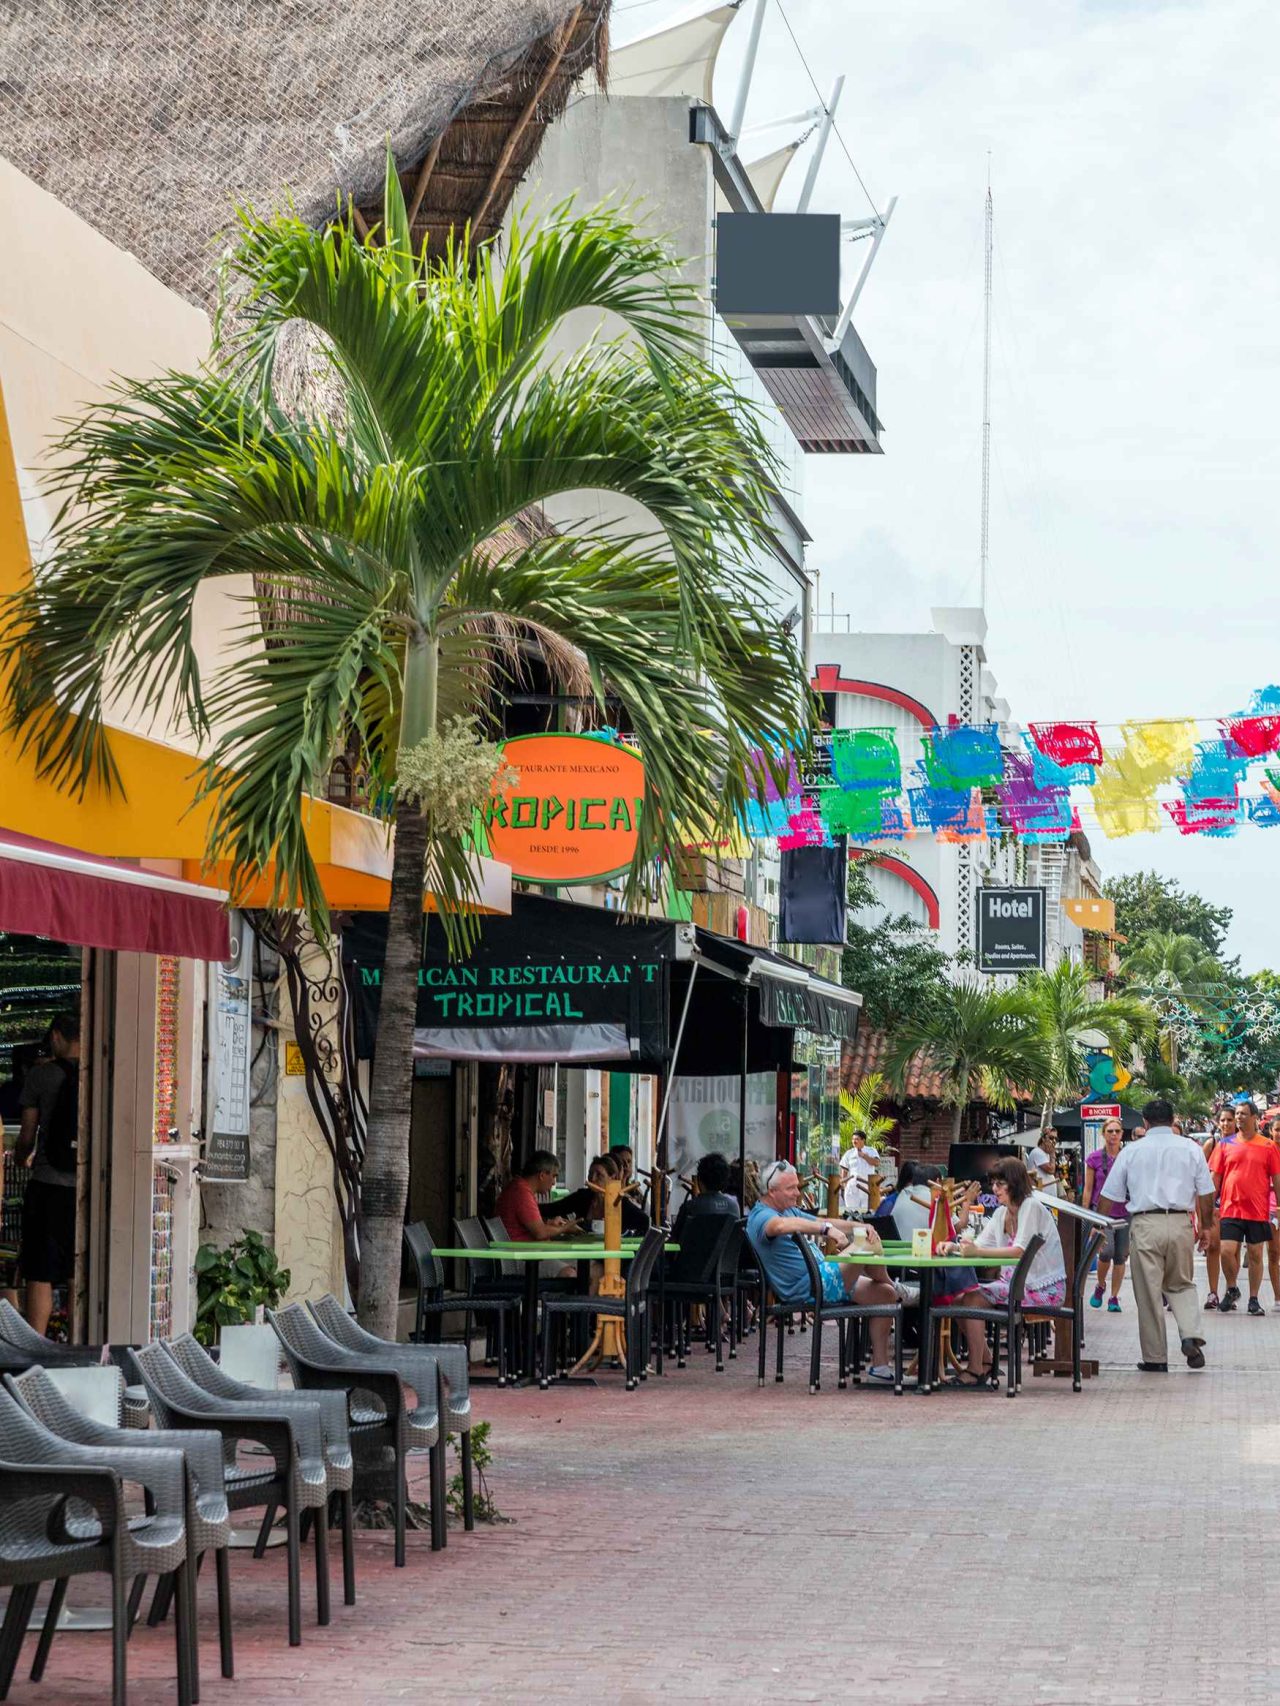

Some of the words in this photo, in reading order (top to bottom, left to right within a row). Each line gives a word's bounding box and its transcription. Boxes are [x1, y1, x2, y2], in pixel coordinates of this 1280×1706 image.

[503, 764, 568, 774] RTAURANTE
[569, 764, 620, 774] MEXICANO
[484, 794, 644, 834] ROPICA
[529, 844, 559, 854] DESDE
[561, 845, 580, 854] 1996
[989, 897, 1033, 918] Hotel
[361, 966, 478, 987] MICAN
[434, 993, 584, 1019] TROPICAL
